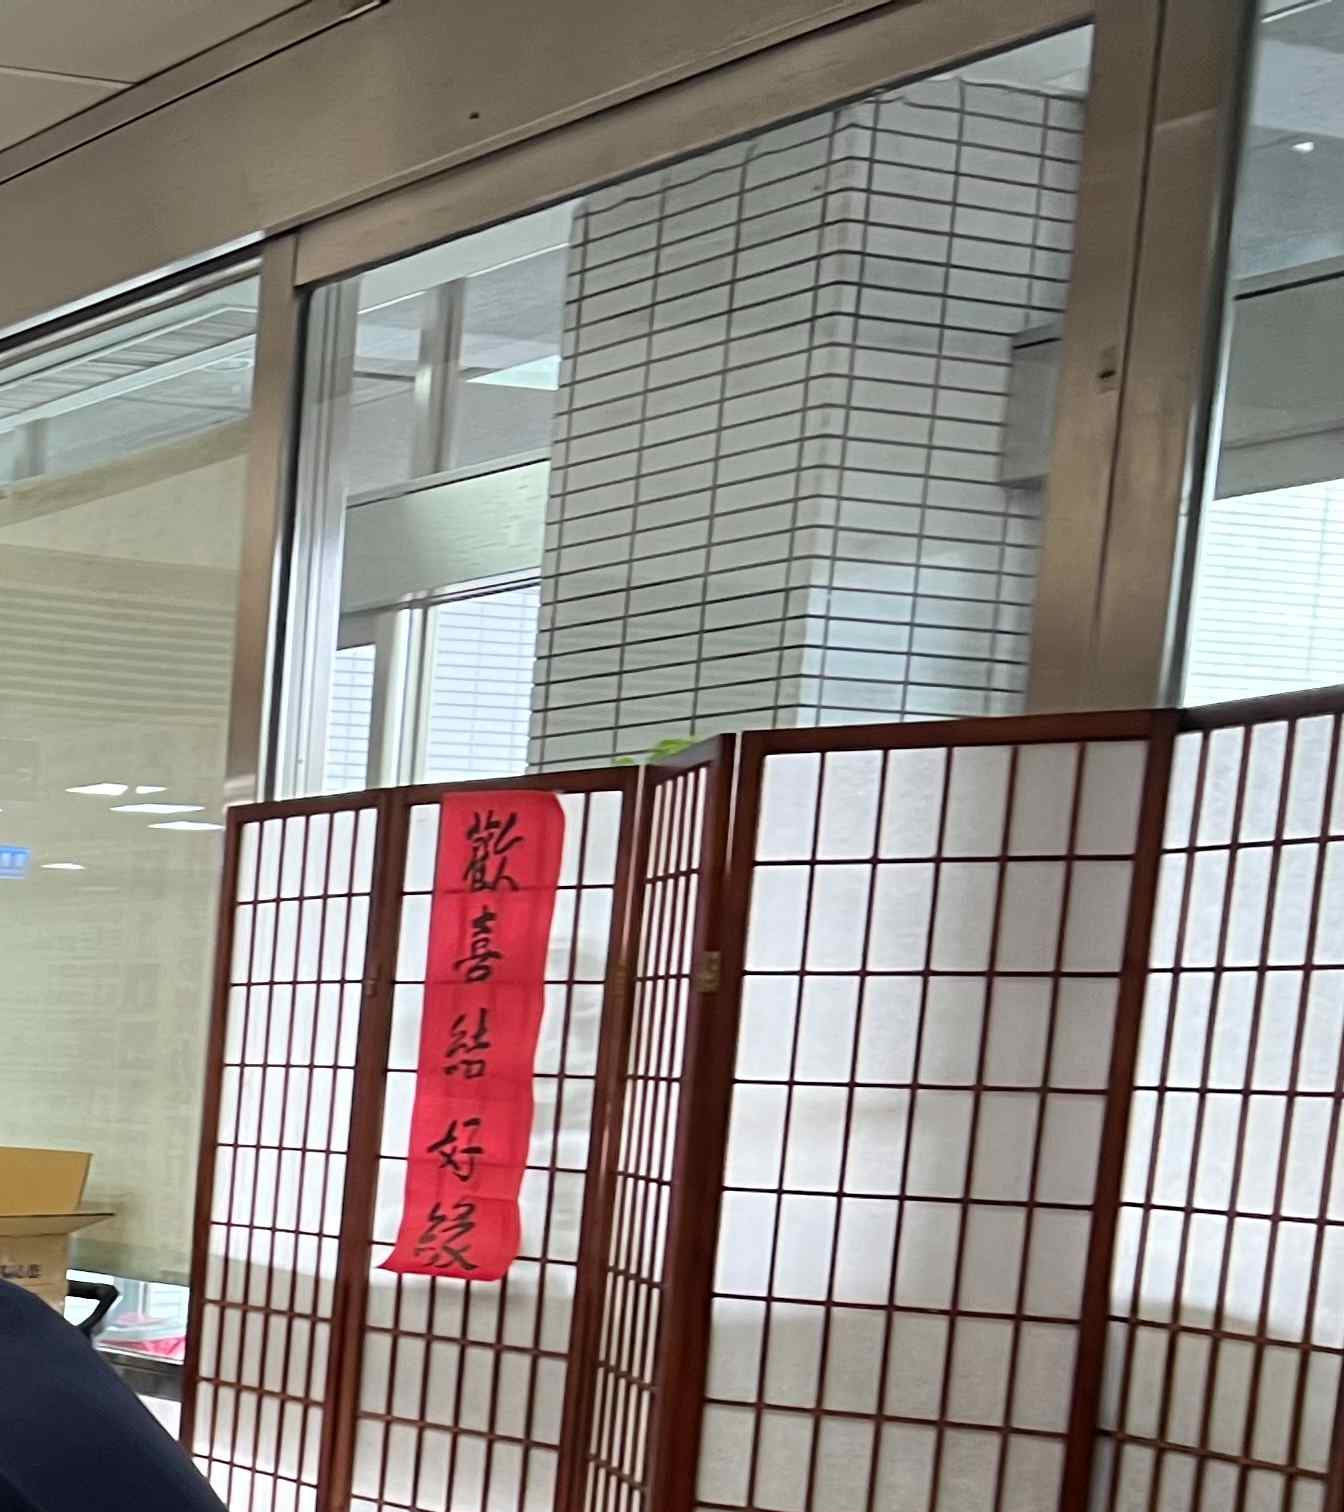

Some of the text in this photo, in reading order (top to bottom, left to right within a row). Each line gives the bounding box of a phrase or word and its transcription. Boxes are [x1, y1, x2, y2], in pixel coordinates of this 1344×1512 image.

[413, 809, 524, 1271] 歡喜結好緣
